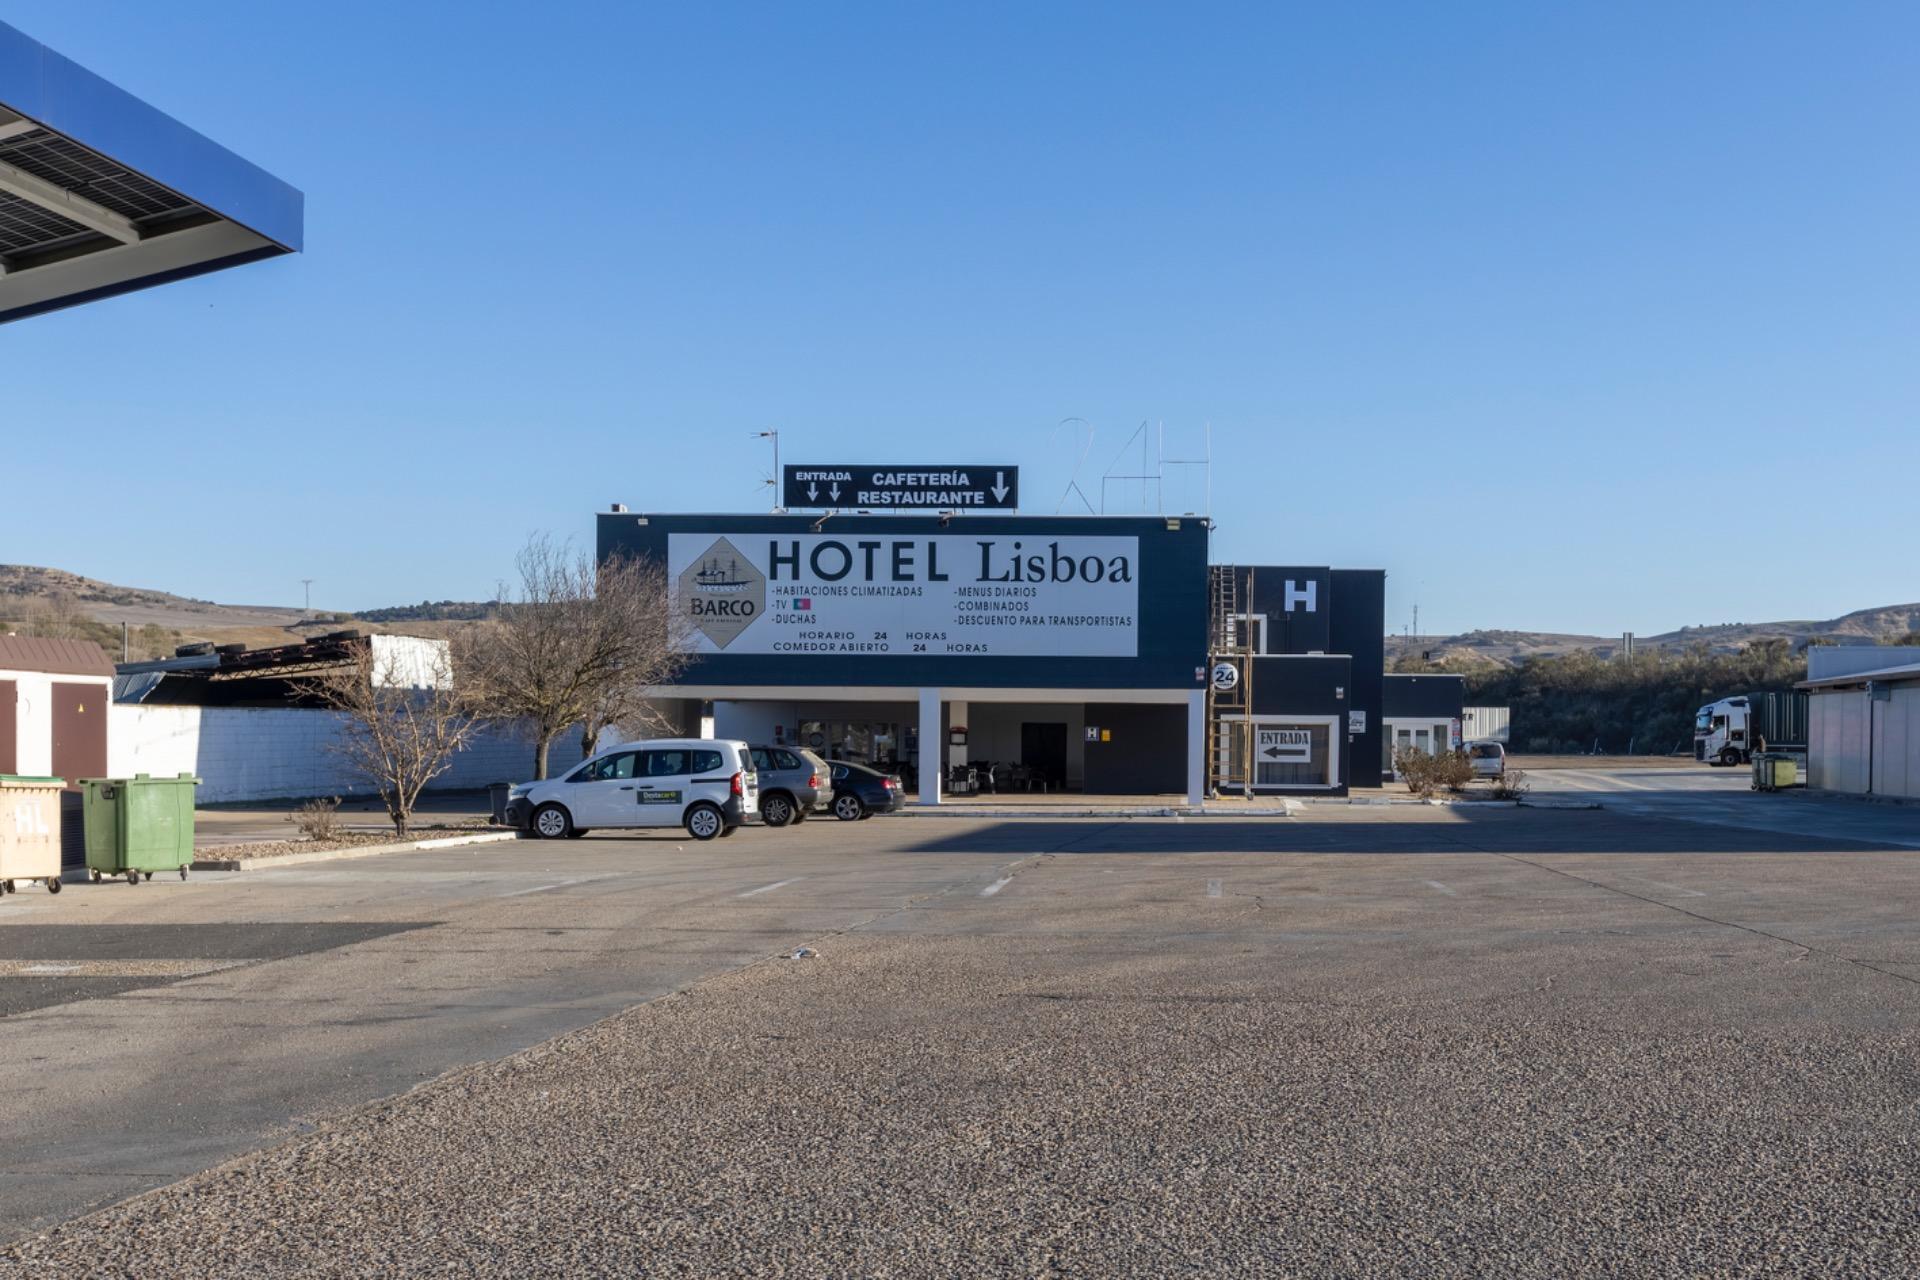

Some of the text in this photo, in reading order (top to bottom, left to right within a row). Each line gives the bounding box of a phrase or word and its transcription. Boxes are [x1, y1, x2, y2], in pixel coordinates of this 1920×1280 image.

[796, 472, 851, 481] ENTRADA
[872, 470, 970, 486] CAFETERÍA
[857, 491, 984, 504] RESTAURANTE
[769, 540, 1132, 583] HOTEL Lisboa
[771, 586, 923, 597] -HABITACIONES CLIMATIZADAS
[954, 587, 1037, 597] -MENUS DIARIOS
[1284, 580, 1317, 612] H
[690, 598, 755, 616] BARCO
[954, 601, 1029, 611] -COMBINADOS
[771, 614, 817, 624] -DUCHAS
[954, 615, 1132, 627] -DESCUENTO PARA TRANSPORTISTAS
[799, 631, 947, 640] HORARIO 24 HORAS
[773, 642, 988, 652] COMEDOR ABIERTO 24 HORAS
[1215, 670, 1235, 682] 24
[1261, 732, 1309, 744] ENTRADA
